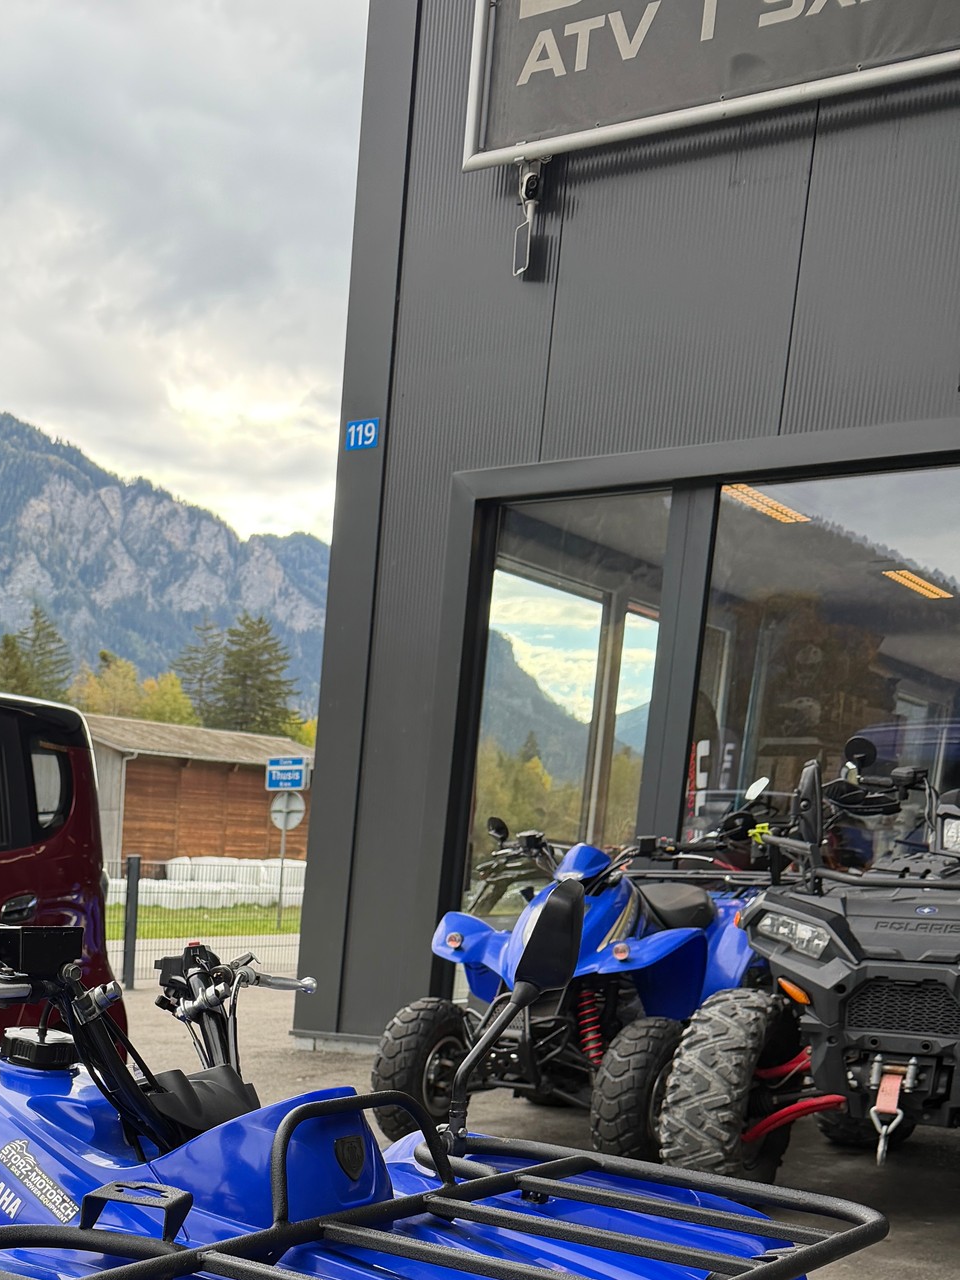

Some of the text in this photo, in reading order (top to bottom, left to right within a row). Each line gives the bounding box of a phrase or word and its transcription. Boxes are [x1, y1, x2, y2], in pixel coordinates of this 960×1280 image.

[516, 1, 661, 86] ATV
[348, 422, 376, 447] 119
[271, 770, 300, 780] Thusis
[874, 921, 960, 934] POLARIS
[1, 1144, 76, 1219] STORZ-MOTOR.CH
[23, 1178, 41, 1197] POWER
[40, 1194, 68, 1223] EQUIPMENT
